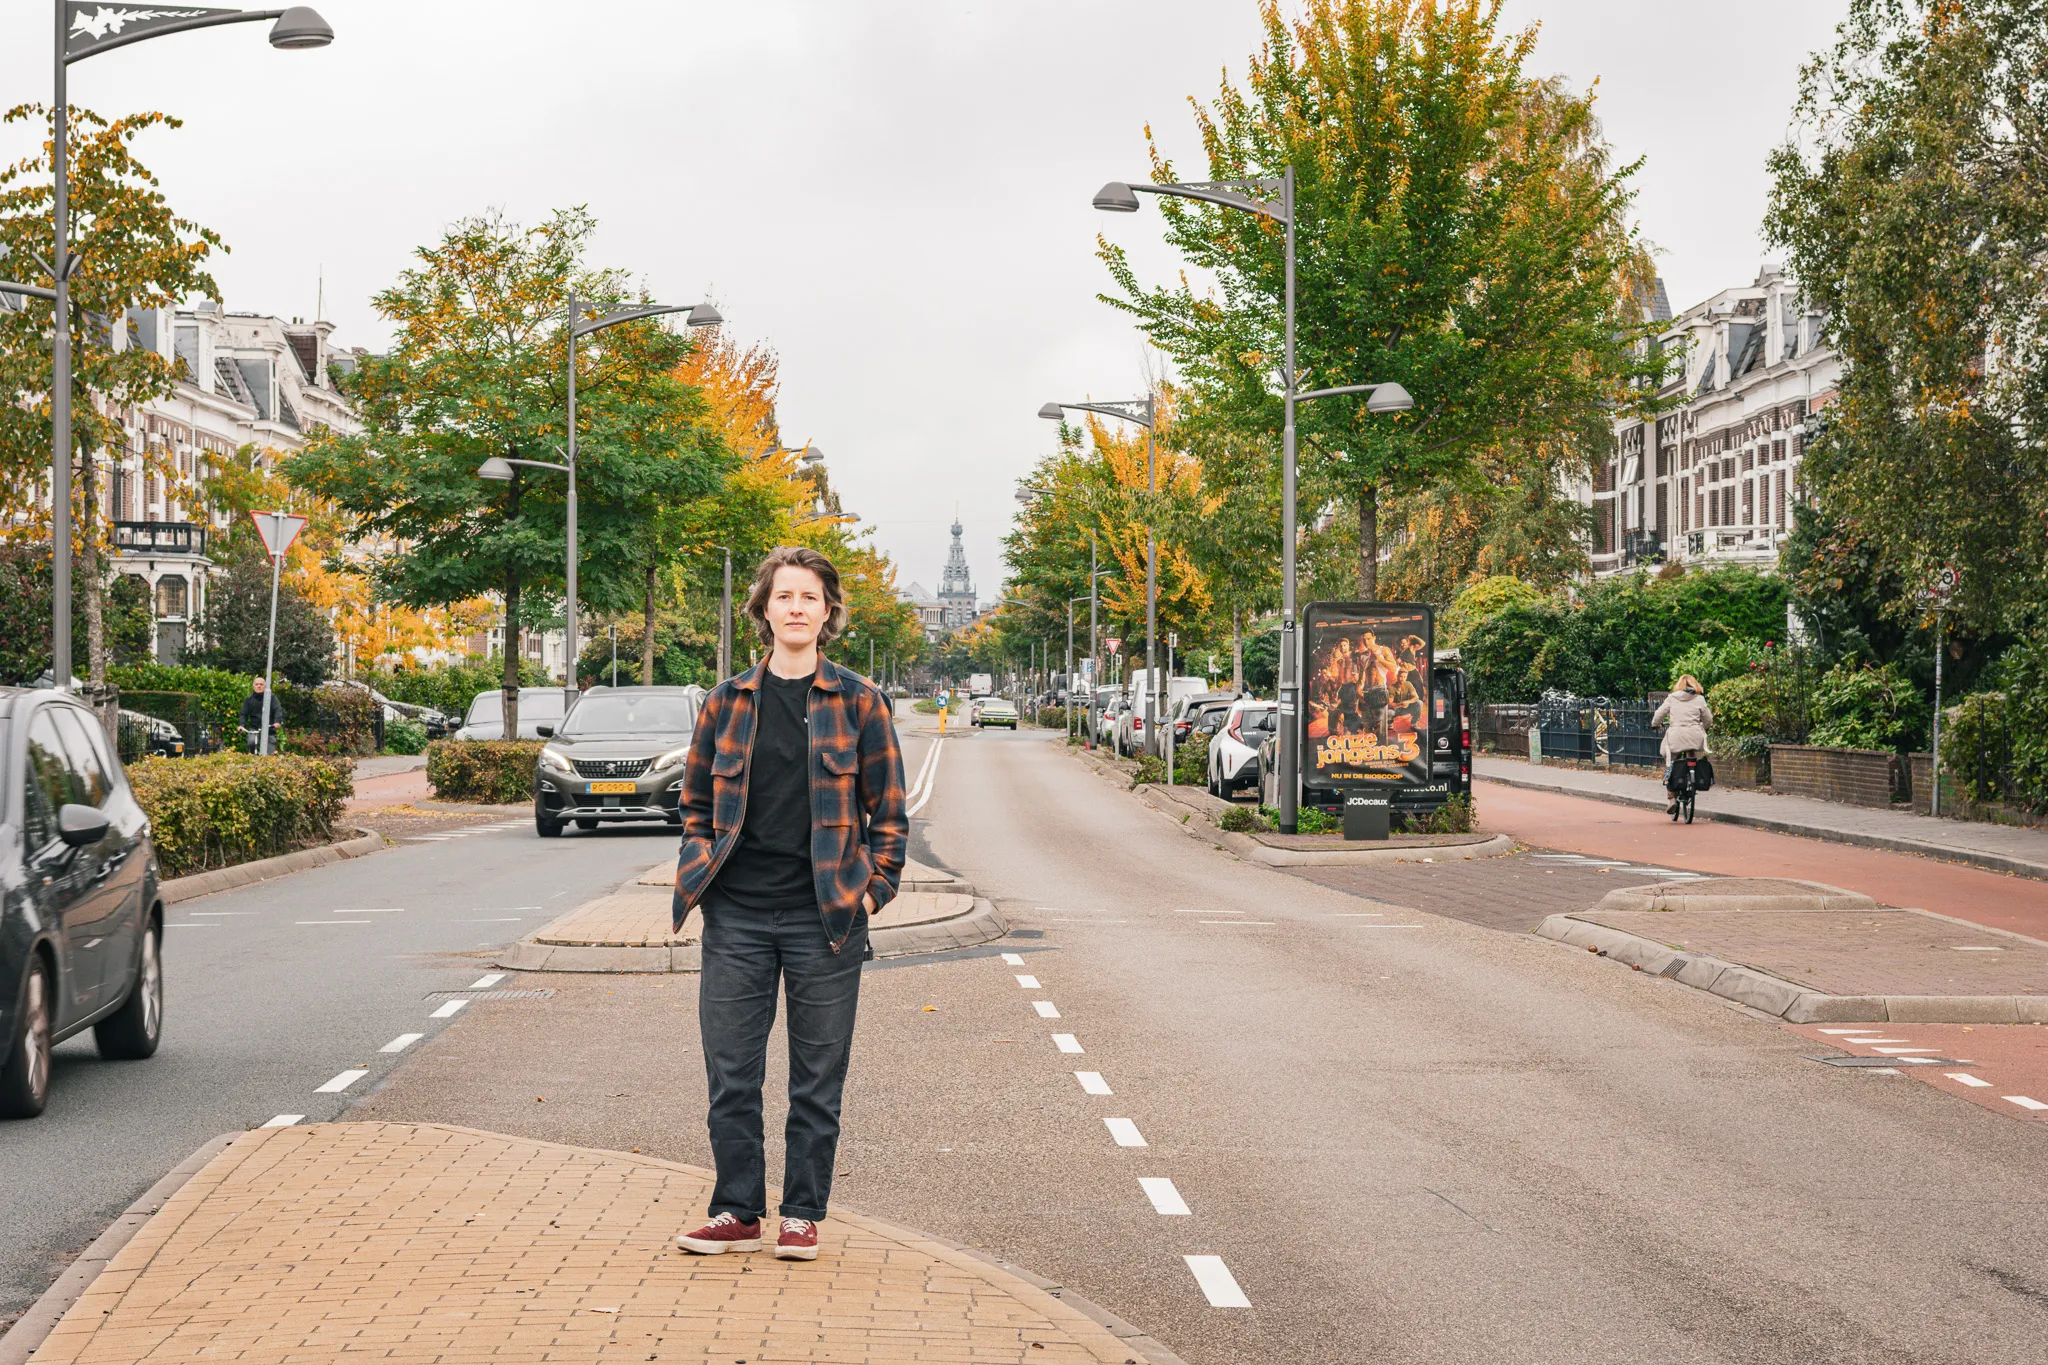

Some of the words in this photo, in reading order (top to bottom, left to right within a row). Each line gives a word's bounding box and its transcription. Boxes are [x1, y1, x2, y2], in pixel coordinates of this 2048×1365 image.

[1327, 733, 1377, 750] onze
[1316, 744, 1400, 769] jongens
[1398, 732, 1419, 761] 3
[1346, 797, 1388, 806] JCDecaux
